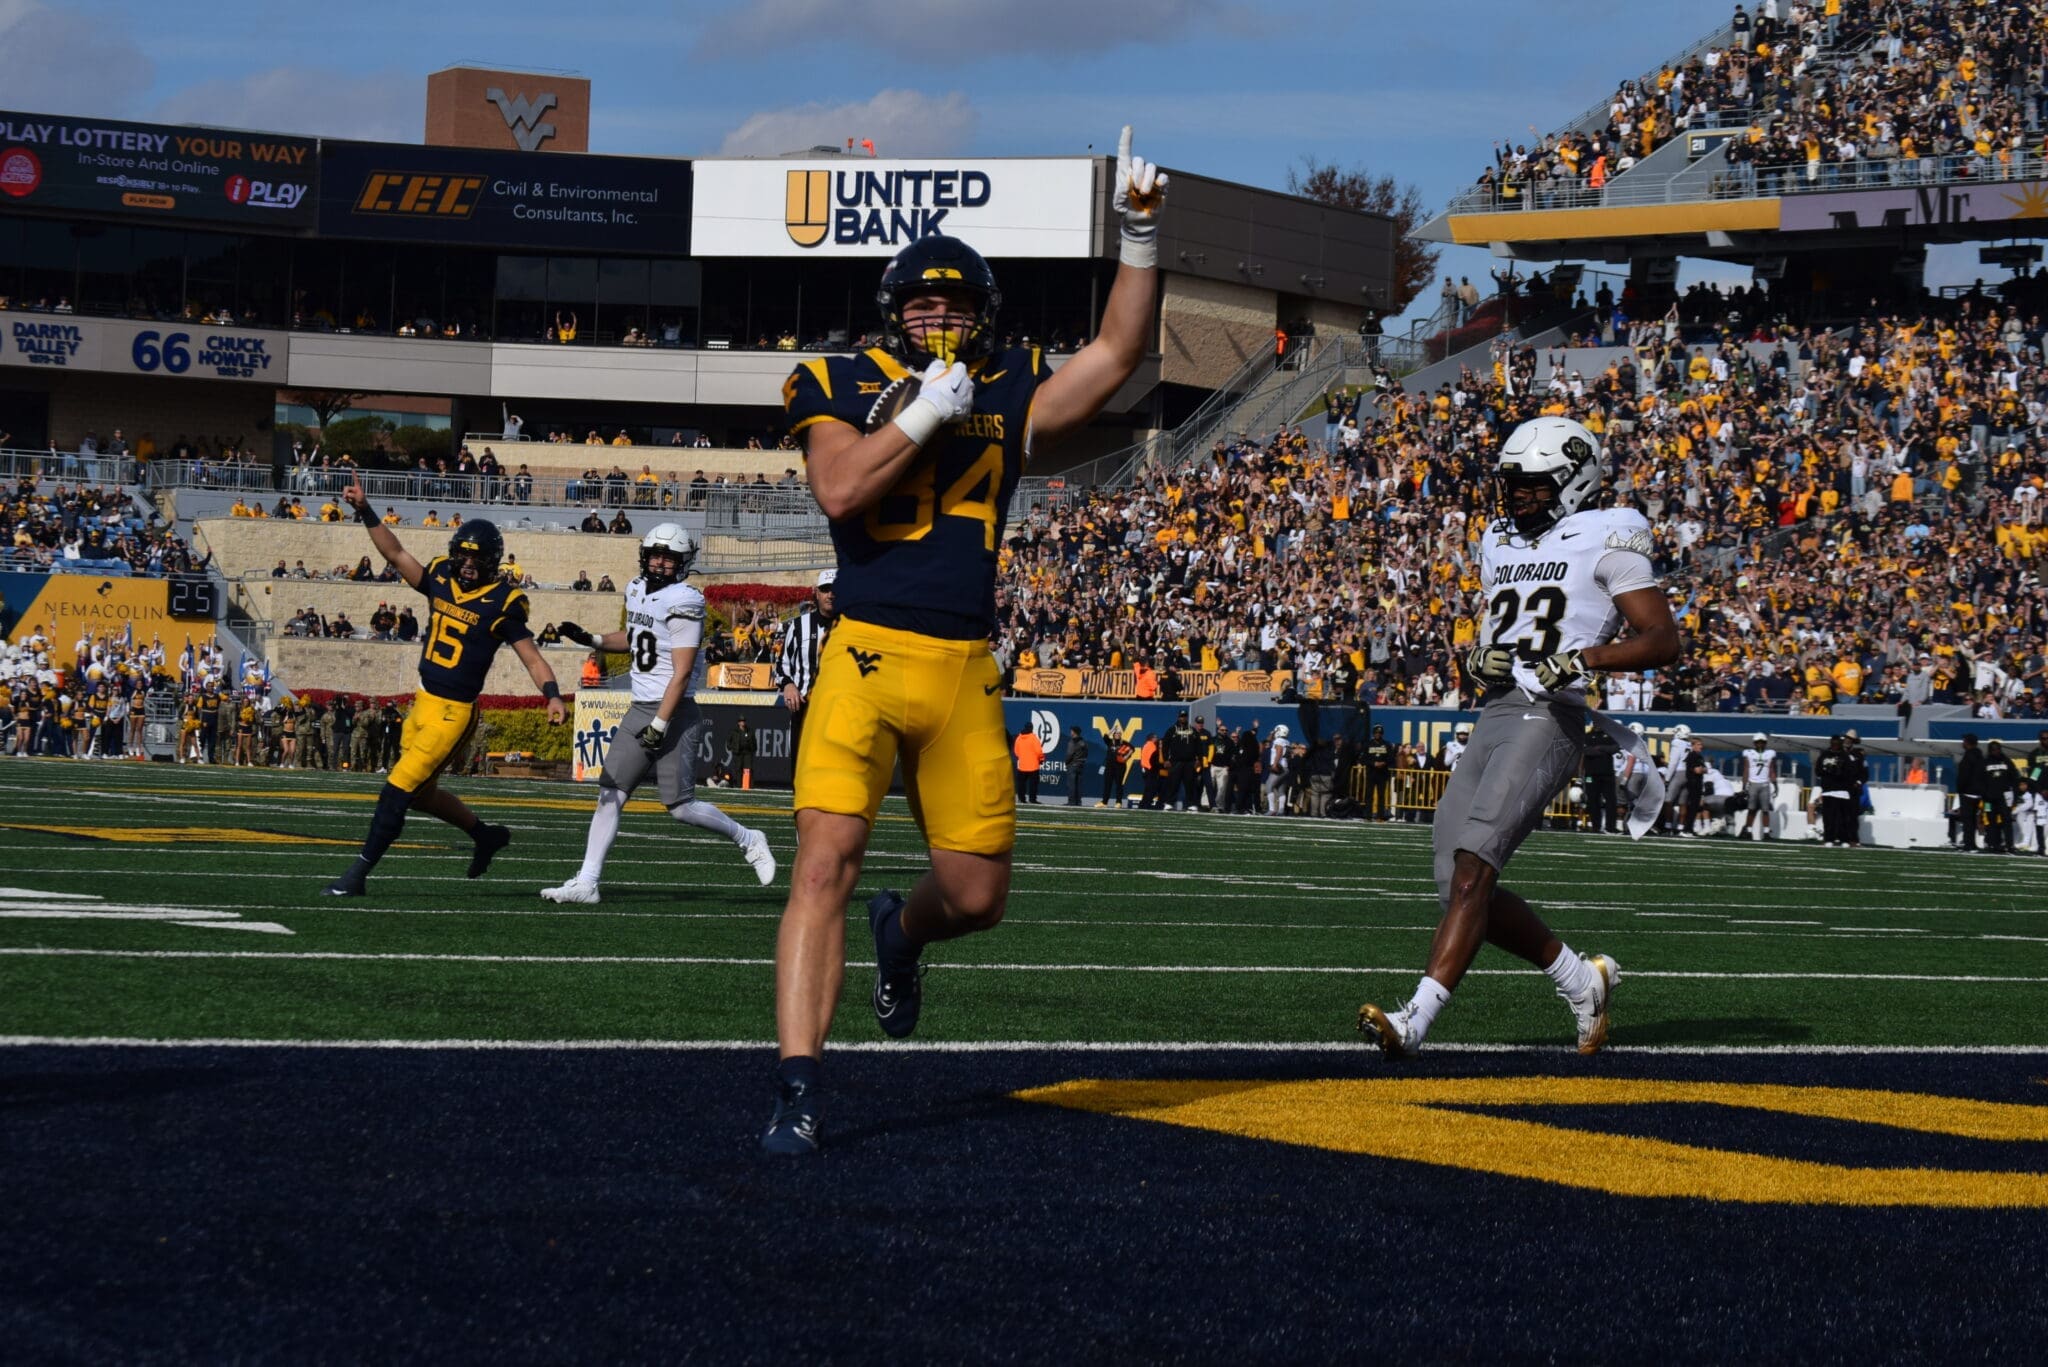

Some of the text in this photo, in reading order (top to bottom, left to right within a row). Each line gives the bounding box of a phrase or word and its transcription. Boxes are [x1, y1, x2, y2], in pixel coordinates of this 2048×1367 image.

[60, 127, 169, 153] LOTTERY
[175, 136, 241, 159] YOUR
[250, 142, 307, 165] WAY
[78, 152, 220, 176] In-Store And Online
[358, 173, 481, 214] CEC
[493, 180, 658, 203] Civil & Environmental
[836, 170, 992, 207] UNITED
[513, 204, 639, 224] Consultants, Inc.
[835, 208, 950, 245] BANK
[13, 321, 83, 342] DARRYL
[16, 337, 79, 356] TALLEY
[132, 330, 191, 374] 66
[206, 335, 265, 354] CHUCK
[198, 350, 272, 370] HOWLEY
[1492, 561, 1568, 586] COLORADO
[173, 584, 210, 612] 25
[44, 601, 163, 620] NEMACOLIN
[1490, 586, 1567, 662] 23
[425, 611, 470, 669] 15
[1039, 771, 1061, 786] nergy
